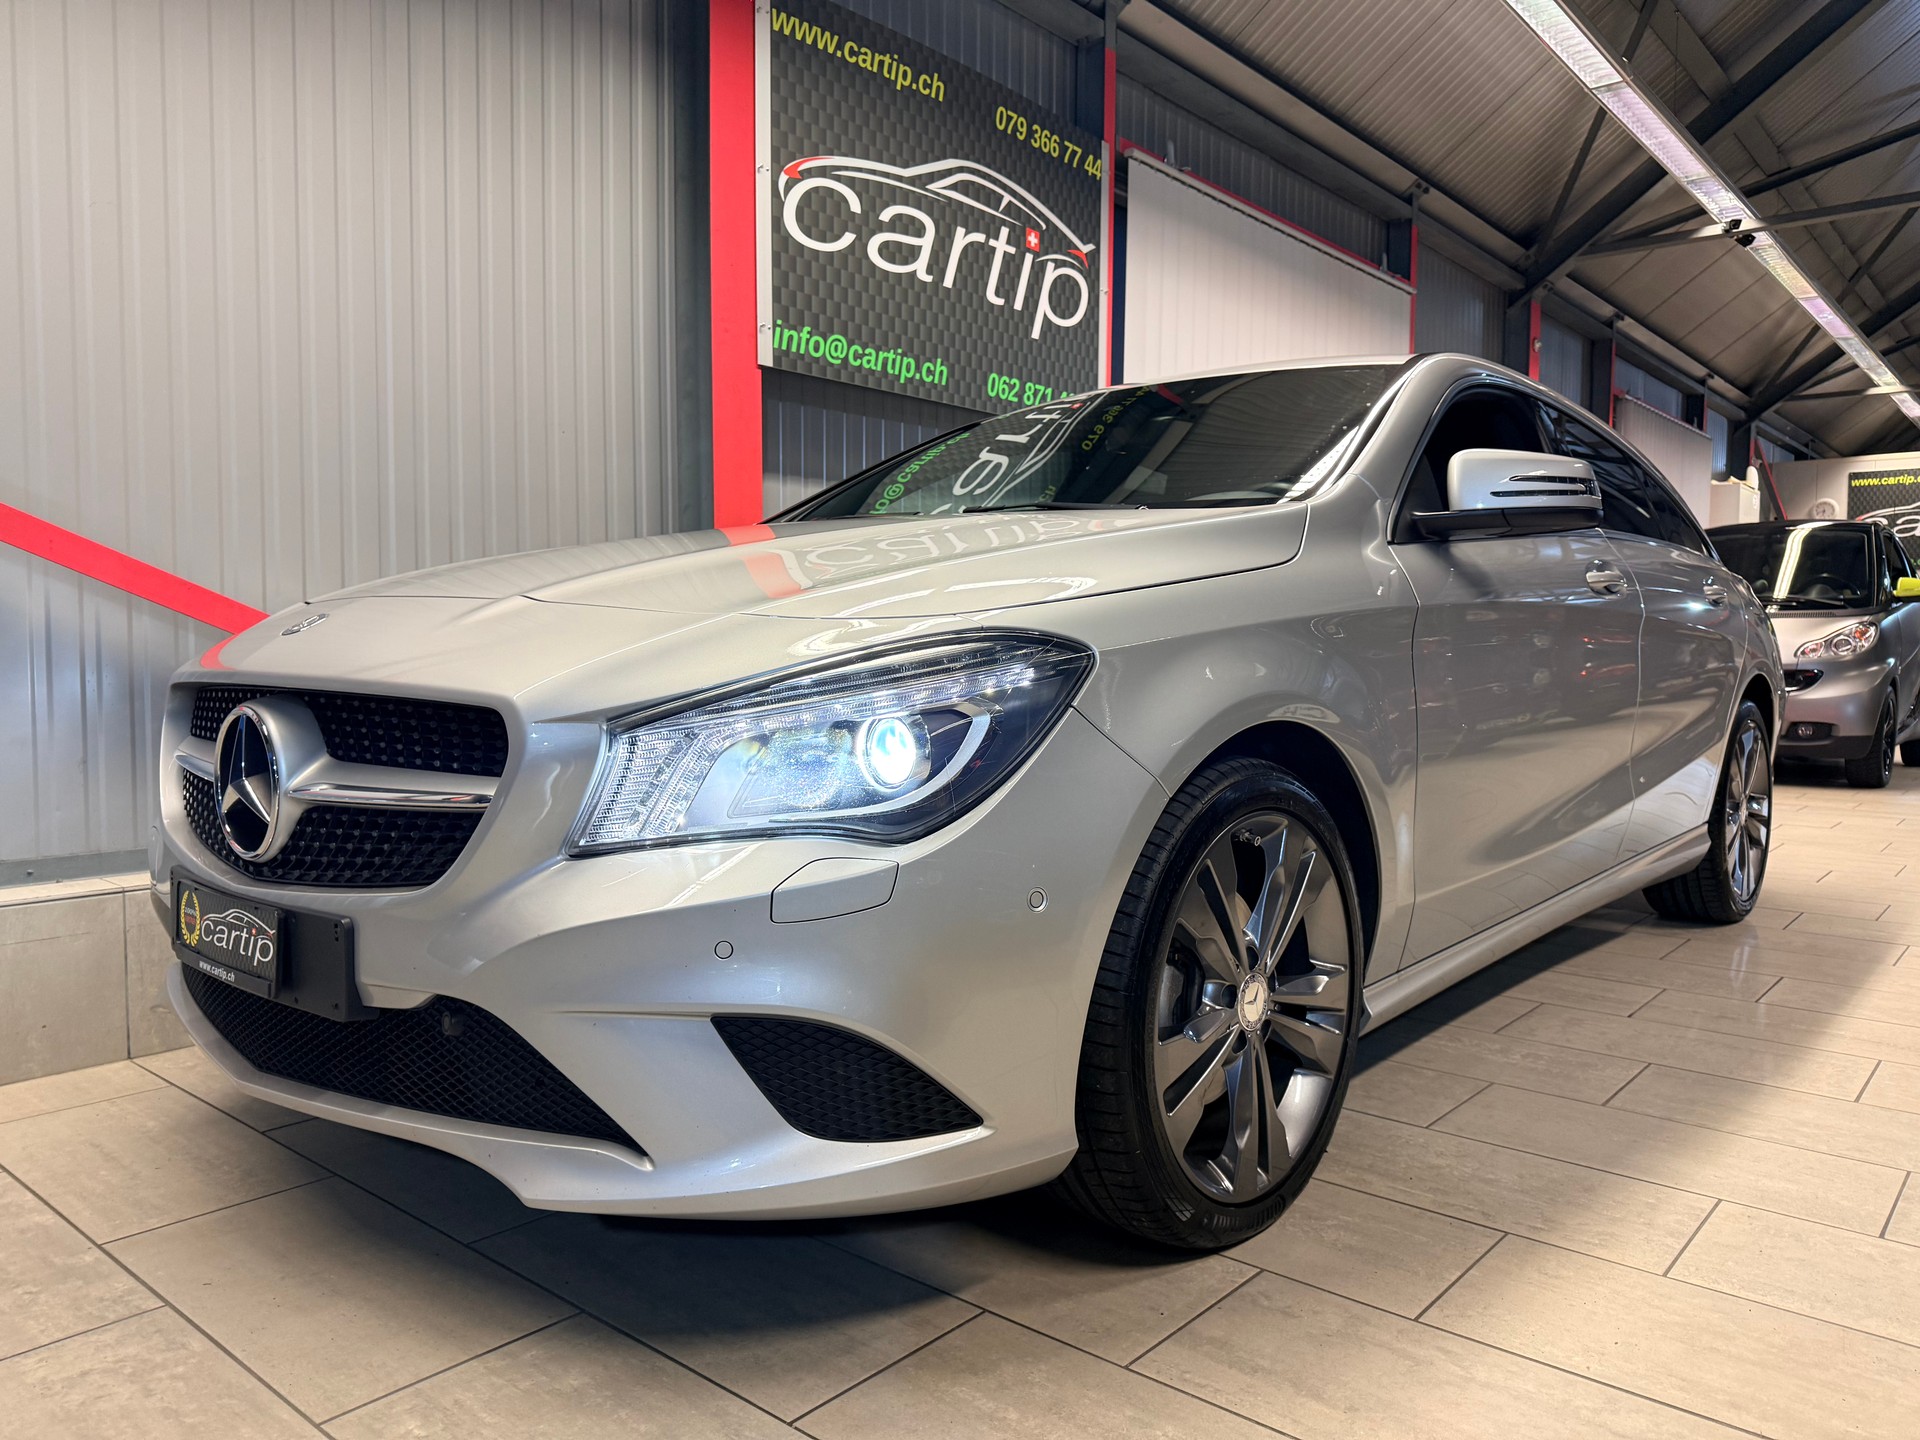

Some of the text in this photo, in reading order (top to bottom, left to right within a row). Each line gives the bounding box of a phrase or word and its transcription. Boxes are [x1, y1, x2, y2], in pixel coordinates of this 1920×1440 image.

[772, 8, 945, 102] www.cartip.ch
[996, 106, 1101, 180] 079 366 77 44
[782, 177, 1089, 340] cartip
[773, 319, 948, 386] info@cartip.ch
[987, 373, 1052, 406] 062 871
[199, 960, 235, 983] www.cartip.ch
[201, 920, 274, 966] cartip
